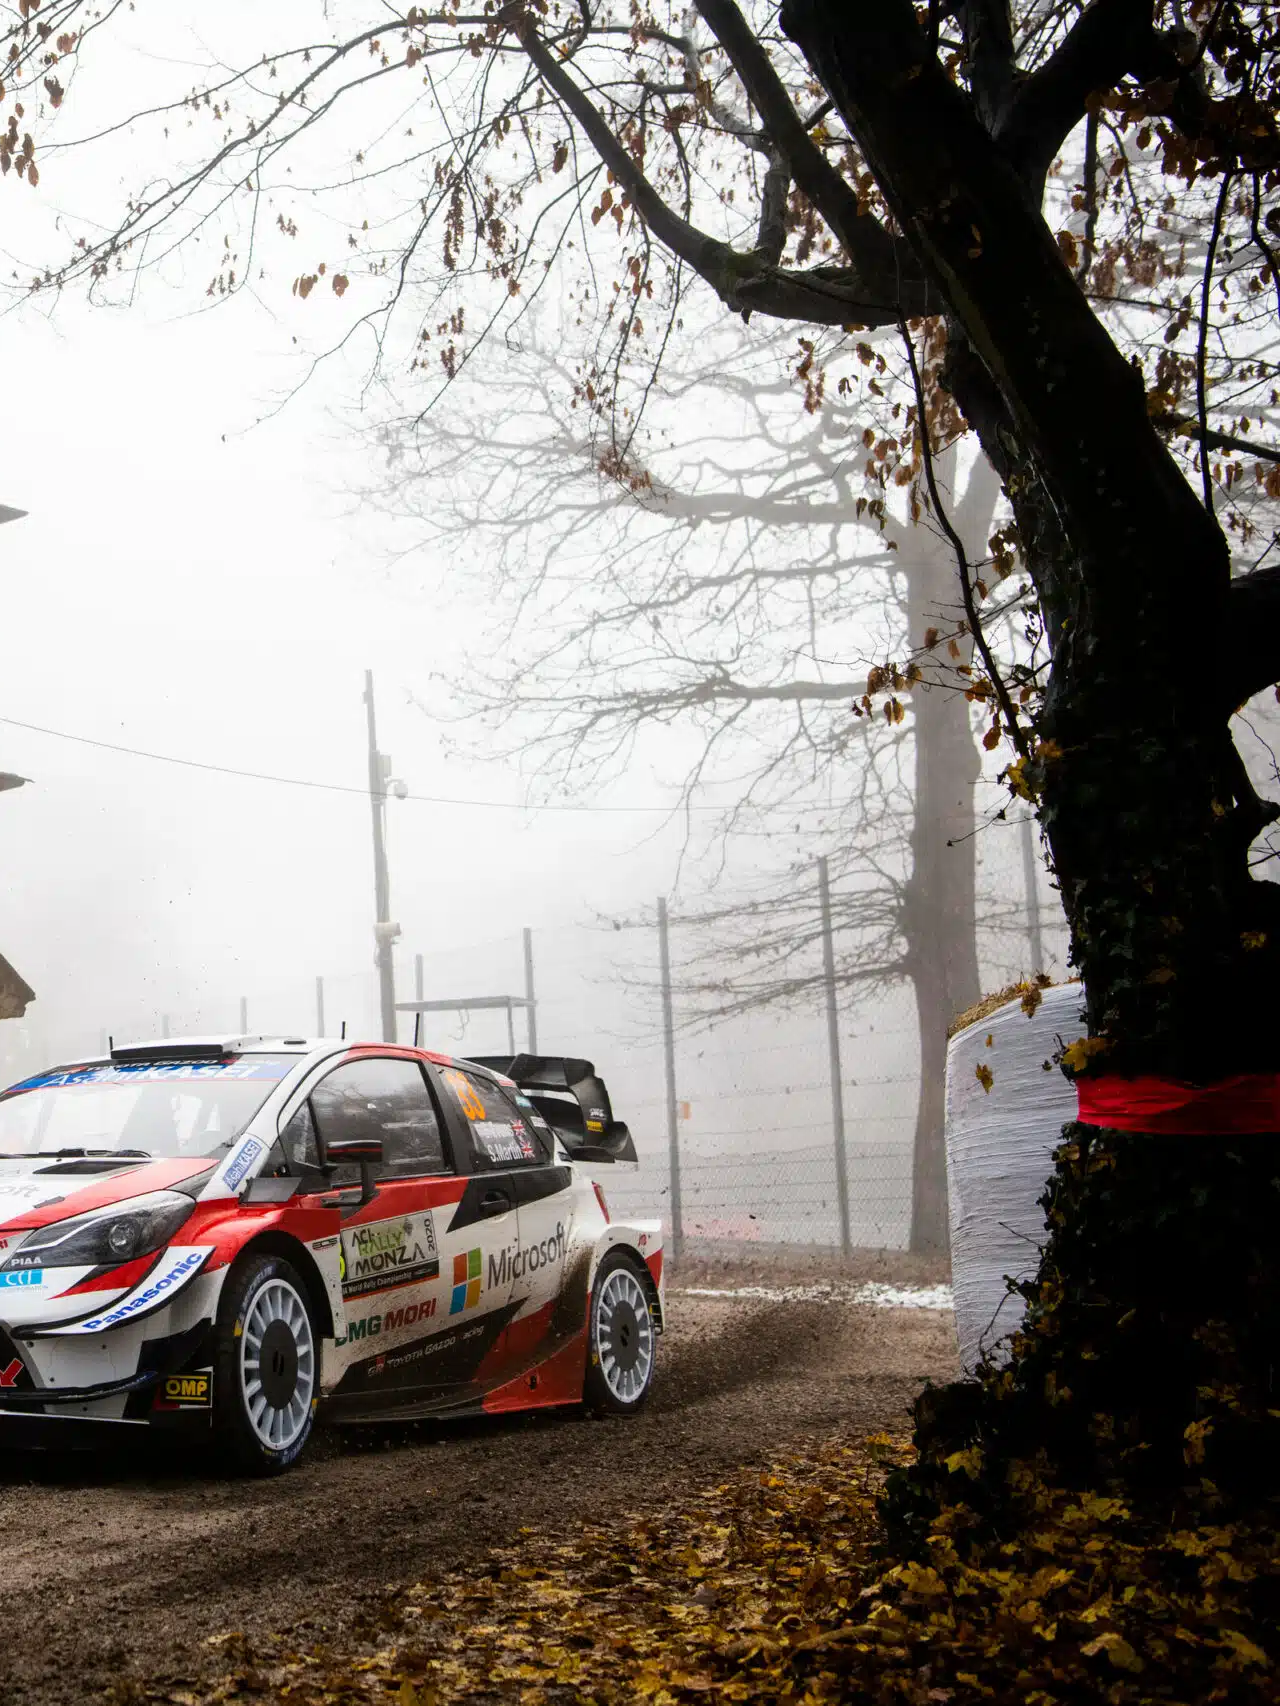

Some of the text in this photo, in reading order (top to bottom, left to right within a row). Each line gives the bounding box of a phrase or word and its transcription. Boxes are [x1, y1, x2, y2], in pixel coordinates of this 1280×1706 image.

[423, 1218, 436, 1251] 2020
[10, 1256, 43, 1267] PIAA
[355, 1242, 426, 1276] MONZA
[487, 1221, 566, 1290] Microsoft
[82, 1252, 202, 1329] Panasonic
[383, 1298, 437, 1331] MORI
[165, 1379, 208, 1396] OMP
